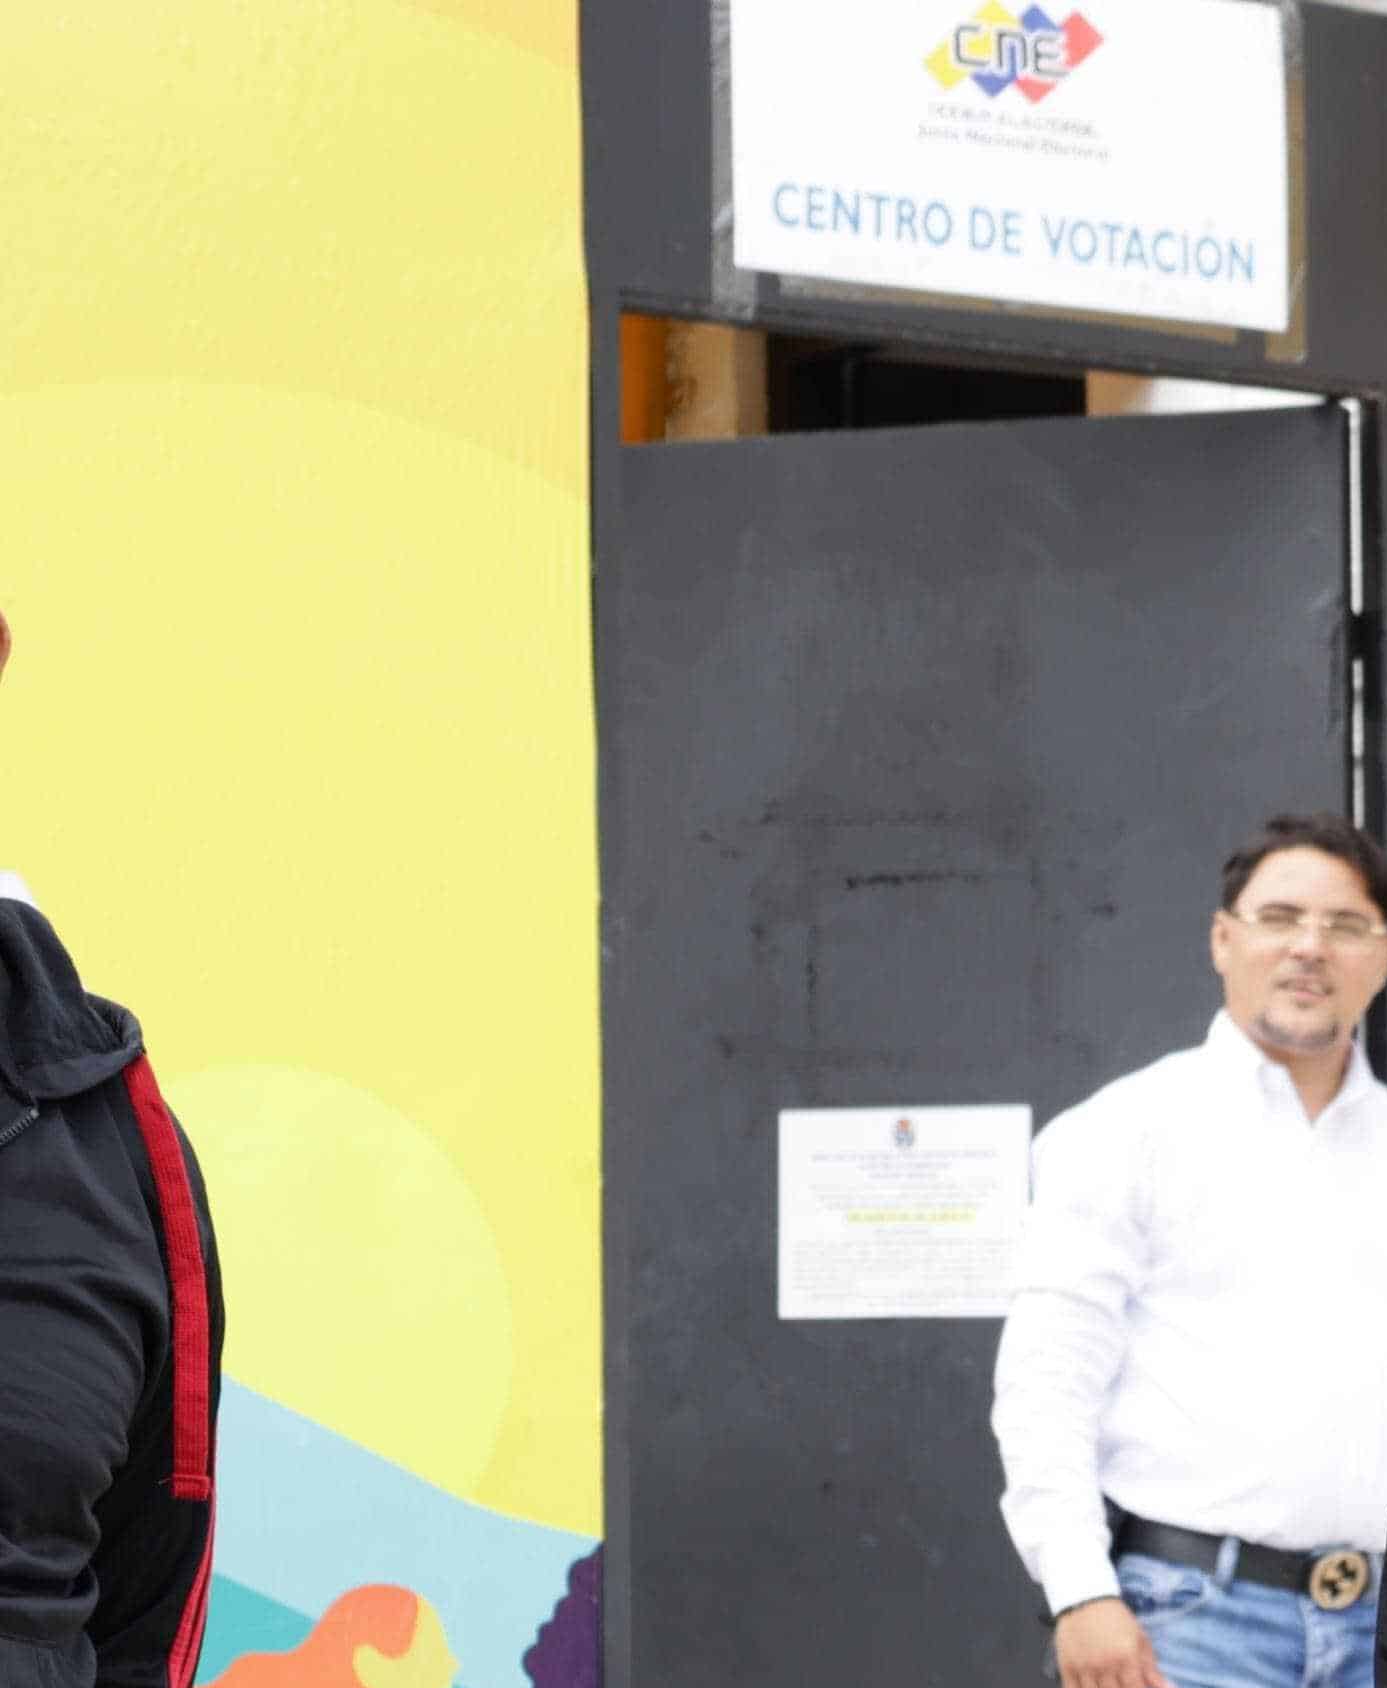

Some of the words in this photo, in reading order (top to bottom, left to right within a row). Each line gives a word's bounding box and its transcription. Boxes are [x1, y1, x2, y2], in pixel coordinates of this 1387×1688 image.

[771, 181, 954, 248] CENTRO
[968, 206, 1023, 256] DE
[1041, 214, 1258, 283] VOTACIÓN
